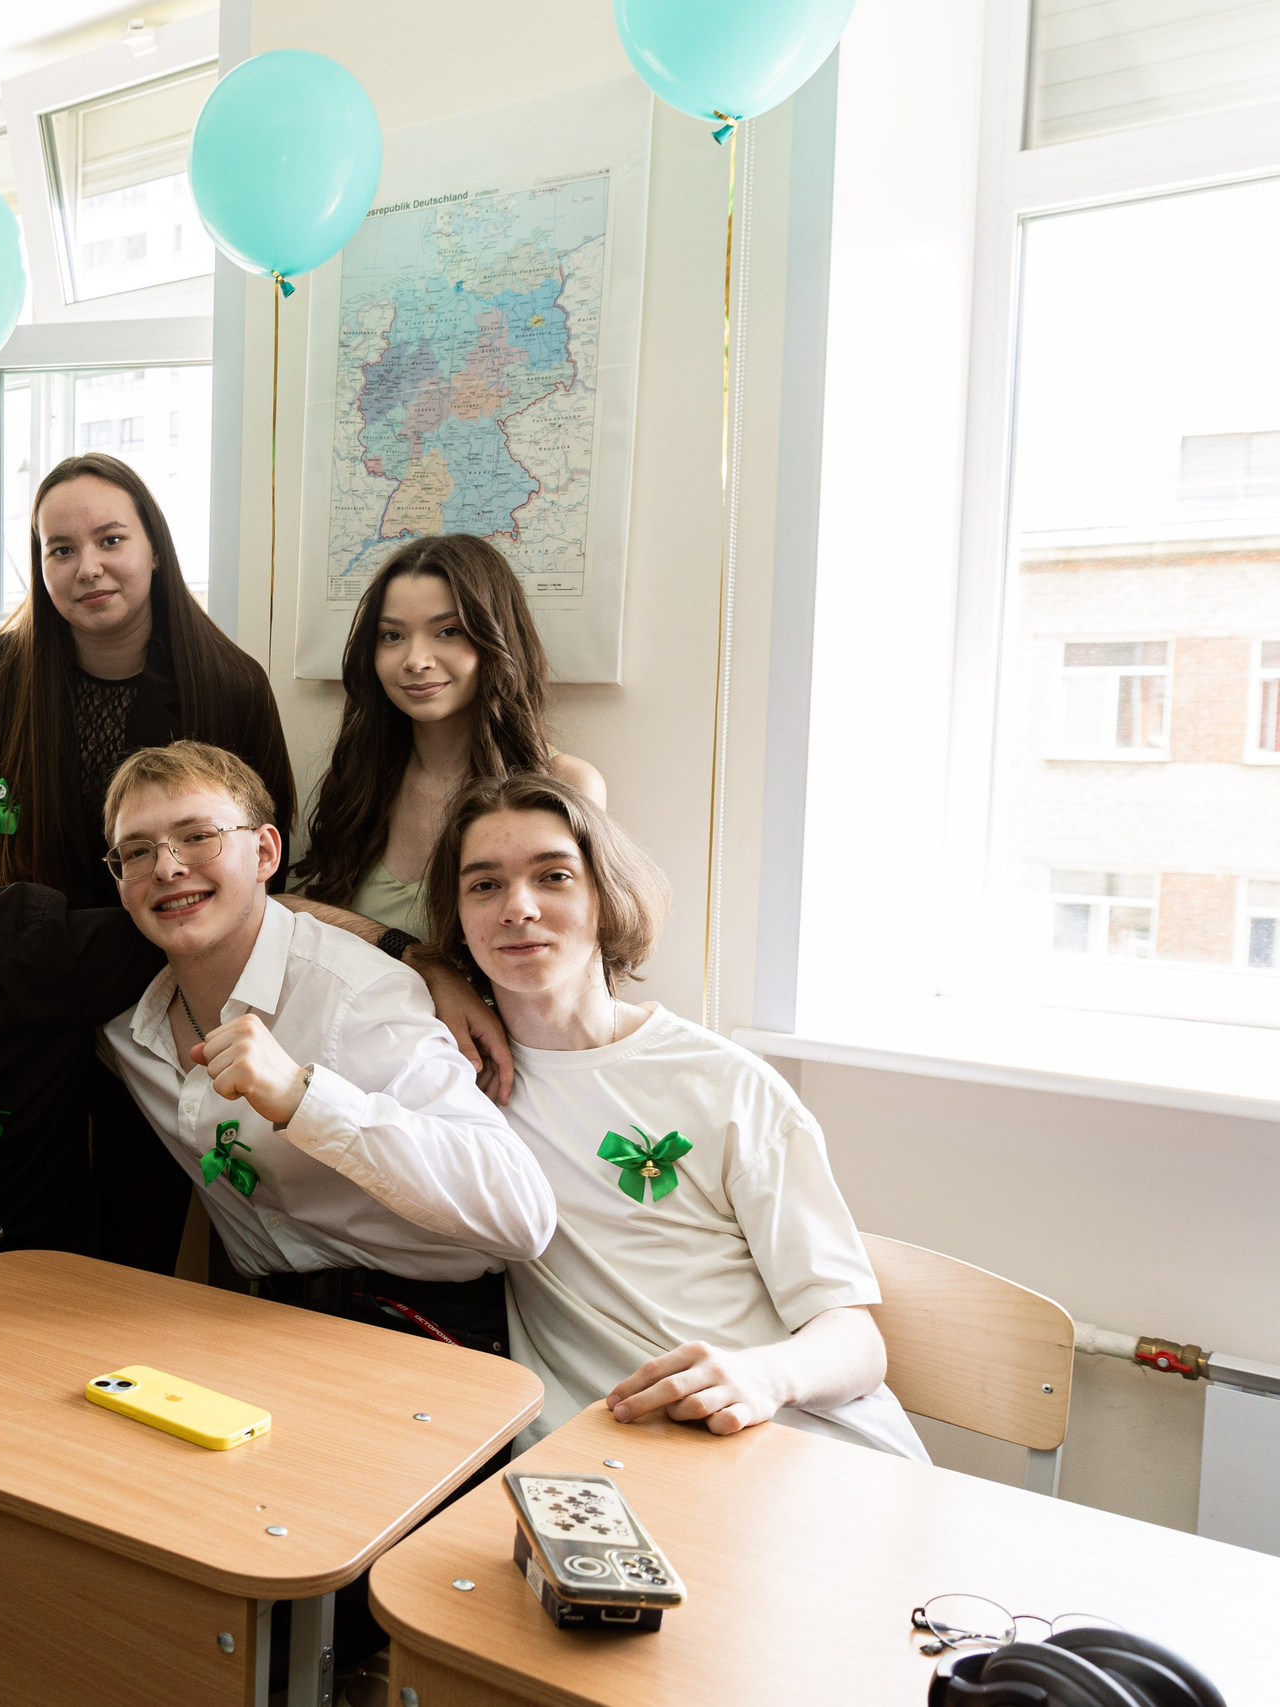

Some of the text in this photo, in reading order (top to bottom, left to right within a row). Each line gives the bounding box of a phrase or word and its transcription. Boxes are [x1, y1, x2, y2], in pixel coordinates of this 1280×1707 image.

[413, 190, 469, 209] Deutschland
[474, 188, 499, 198] politisch
[414, 1314, 459, 1346] ОСТОРОЖН
